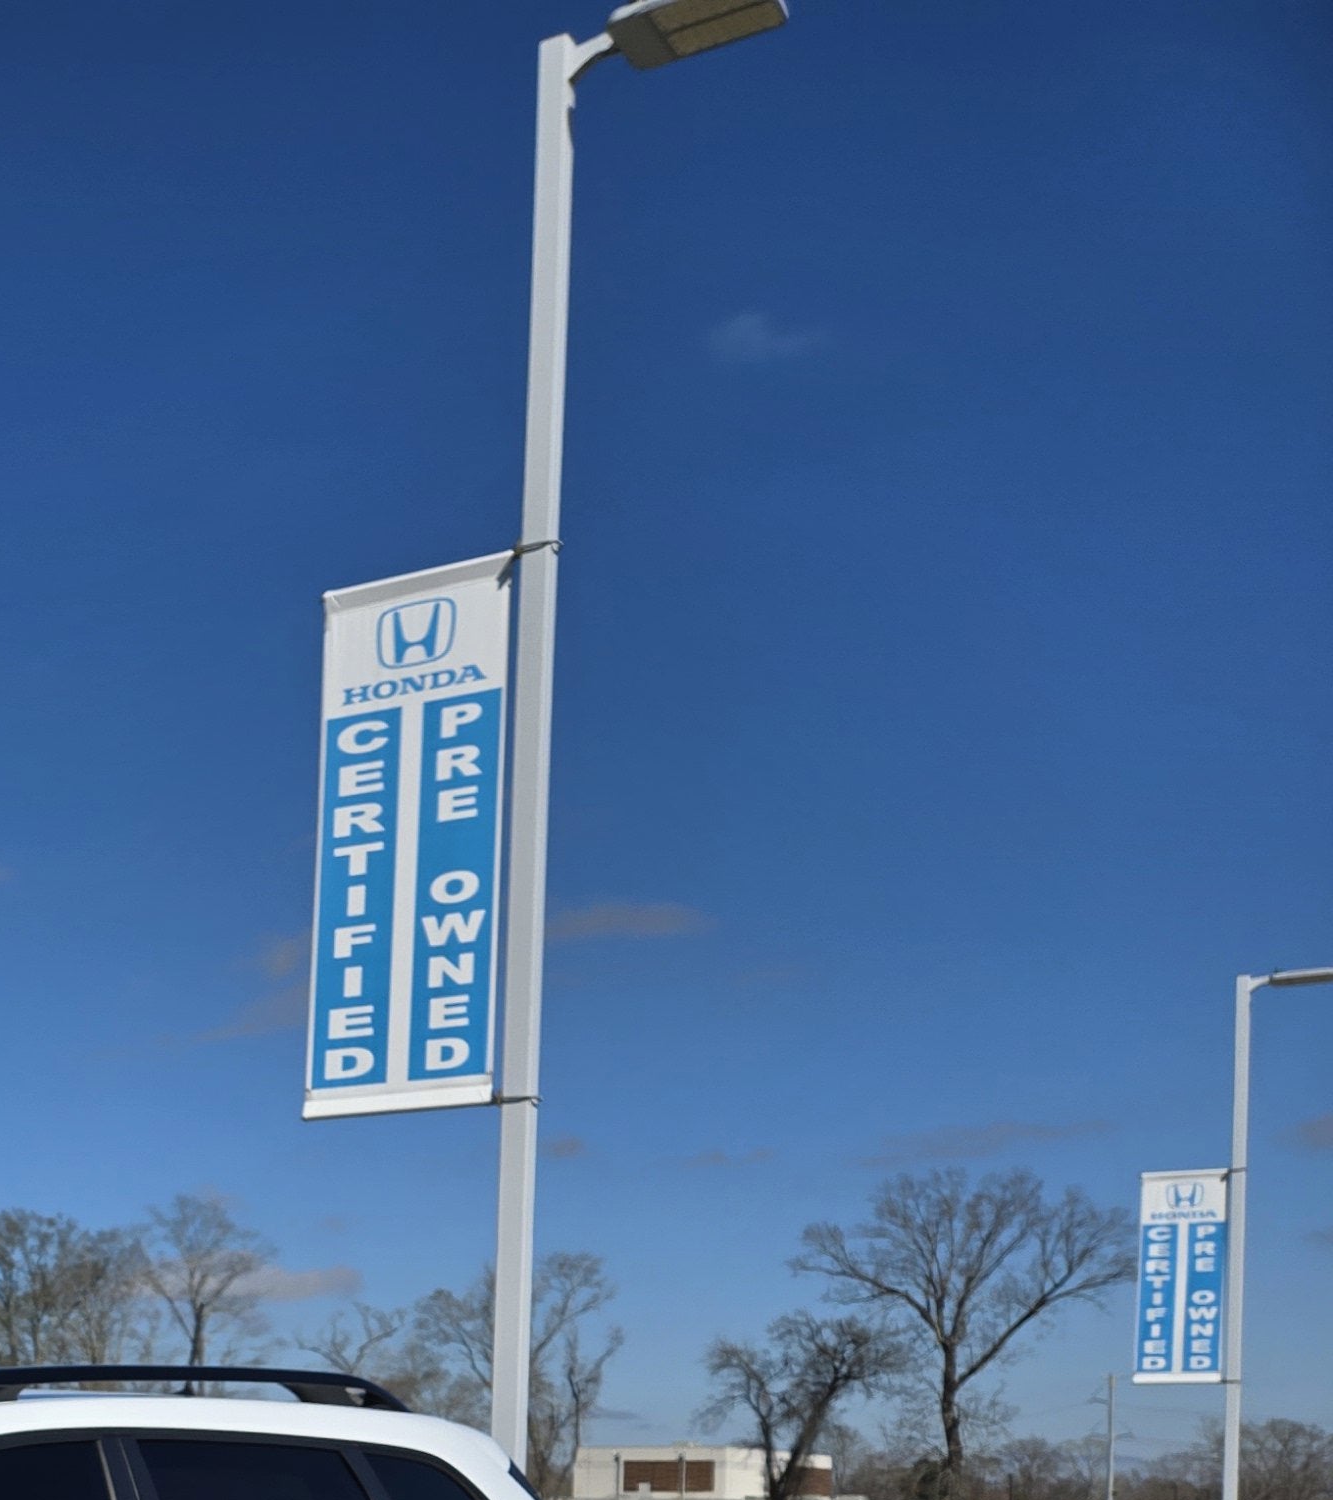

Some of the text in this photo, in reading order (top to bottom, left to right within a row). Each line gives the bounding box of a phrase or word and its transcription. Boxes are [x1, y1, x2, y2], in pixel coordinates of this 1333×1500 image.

[342, 664, 487, 706] HONDA
[323, 719, 390, 1081] CERTIFIED
[421, 702, 486, 1072] PRE OWNED
[1142, 1226, 1173, 1371] CERTIFIED
[1188, 1225, 1218, 1371] PRE OWNED
